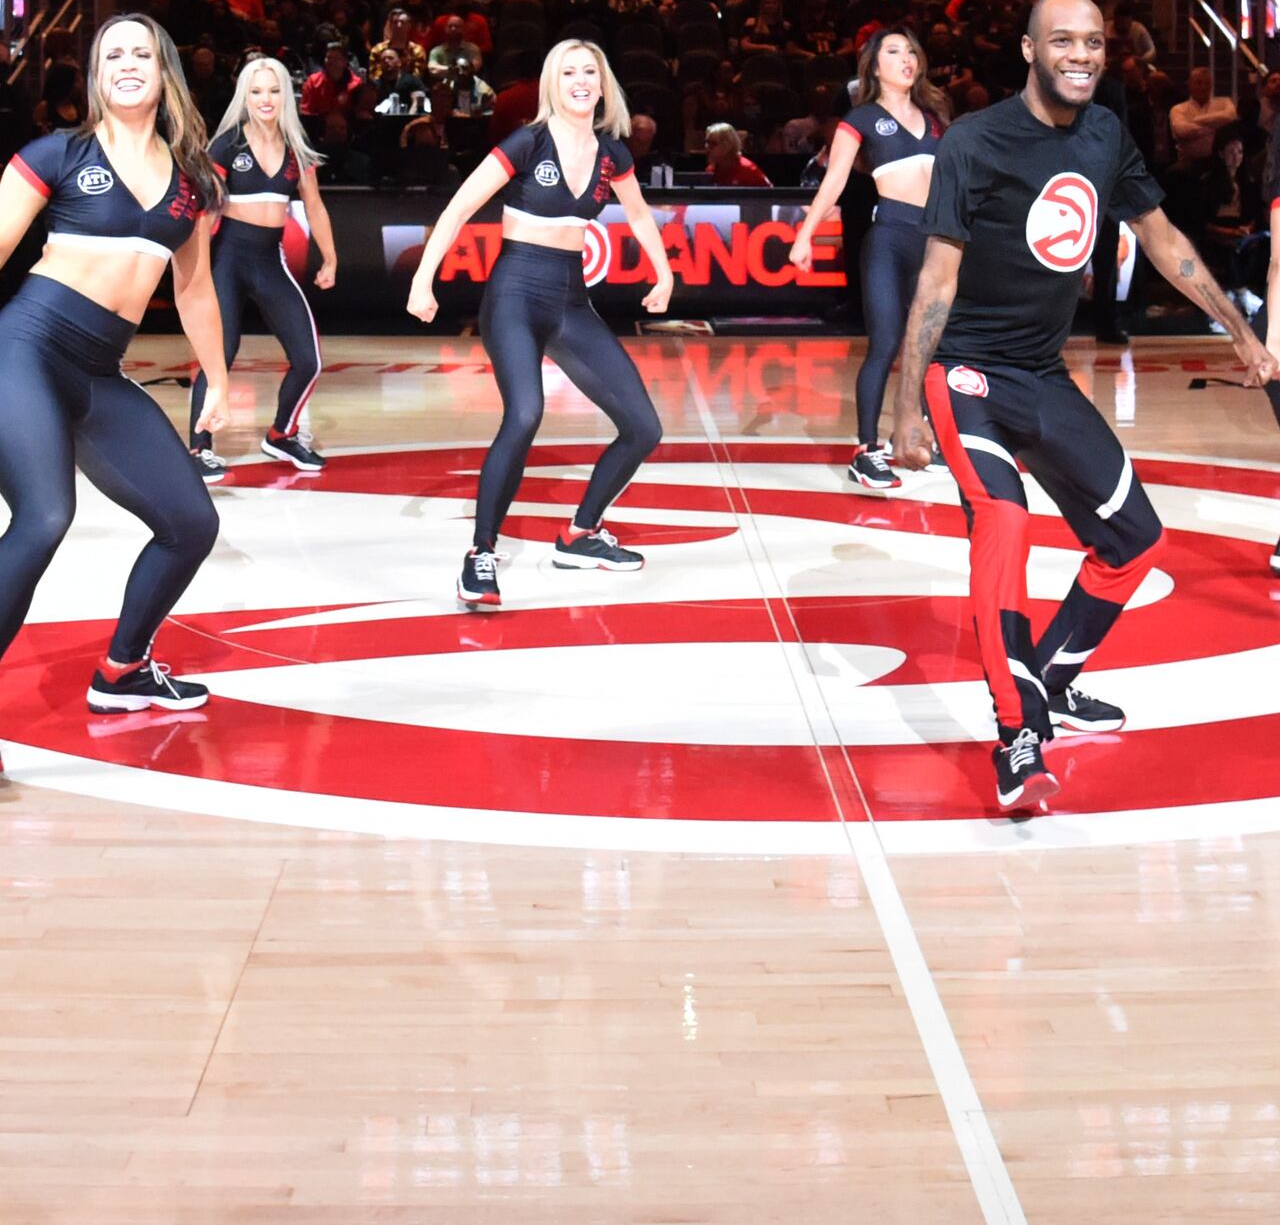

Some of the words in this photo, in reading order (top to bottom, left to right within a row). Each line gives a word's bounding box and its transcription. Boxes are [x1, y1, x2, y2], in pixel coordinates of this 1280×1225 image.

[82, 170, 109, 187] ATL
[537, 166, 557, 181] ATL
[439, 221, 505, 283] AT
[606, 221, 848, 288] DANCE
